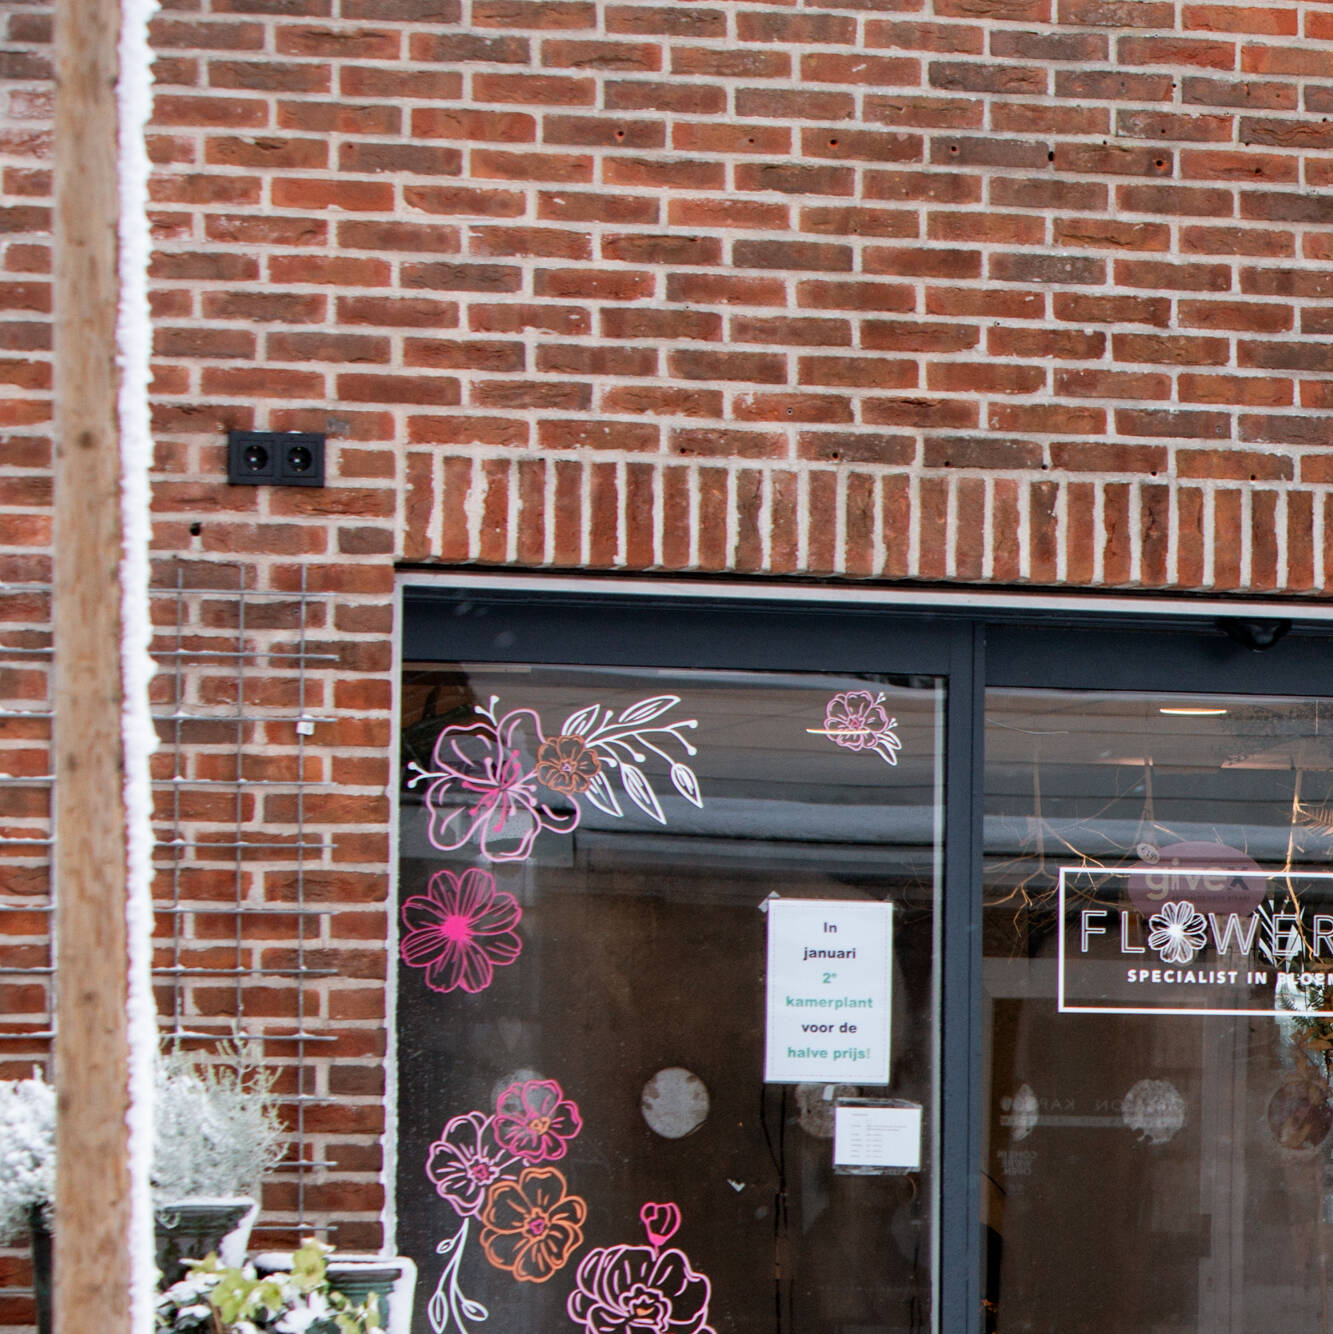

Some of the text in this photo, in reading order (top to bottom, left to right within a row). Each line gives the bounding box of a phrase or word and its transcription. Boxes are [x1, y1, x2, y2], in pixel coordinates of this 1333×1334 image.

[823, 922, 838, 933] In
[803, 947, 857, 960] januari
[1127, 969, 1238, 985] SPECIALIST
[1247, 971, 1268, 985] IN
[786, 996, 873, 1009] kamerplant
[801, 1022, 858, 1033] voor de
[787, 1046, 871, 1061] halve prijs!
